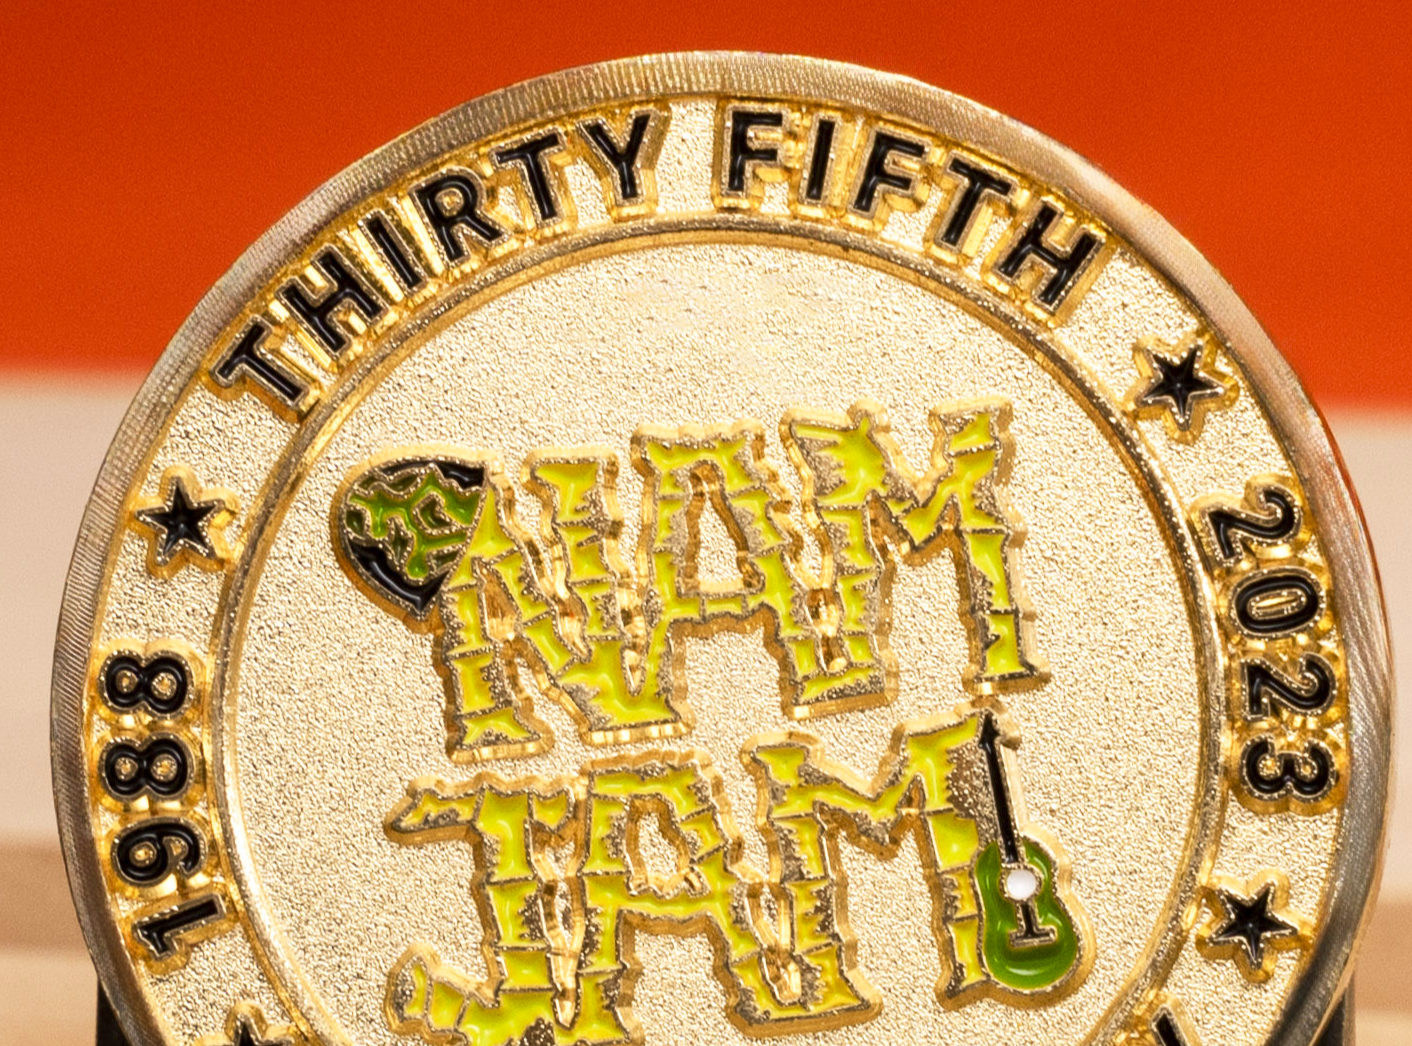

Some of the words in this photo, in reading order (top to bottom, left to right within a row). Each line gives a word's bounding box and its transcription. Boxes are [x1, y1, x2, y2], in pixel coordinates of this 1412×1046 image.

[210, 110, 656, 405] THIRTY
[723, 108, 1104, 310] FIFTH
[440, 400, 1042, 754] NAM
[1206, 486, 1338, 800] 2023
[102, 654, 227, 960] 1988
